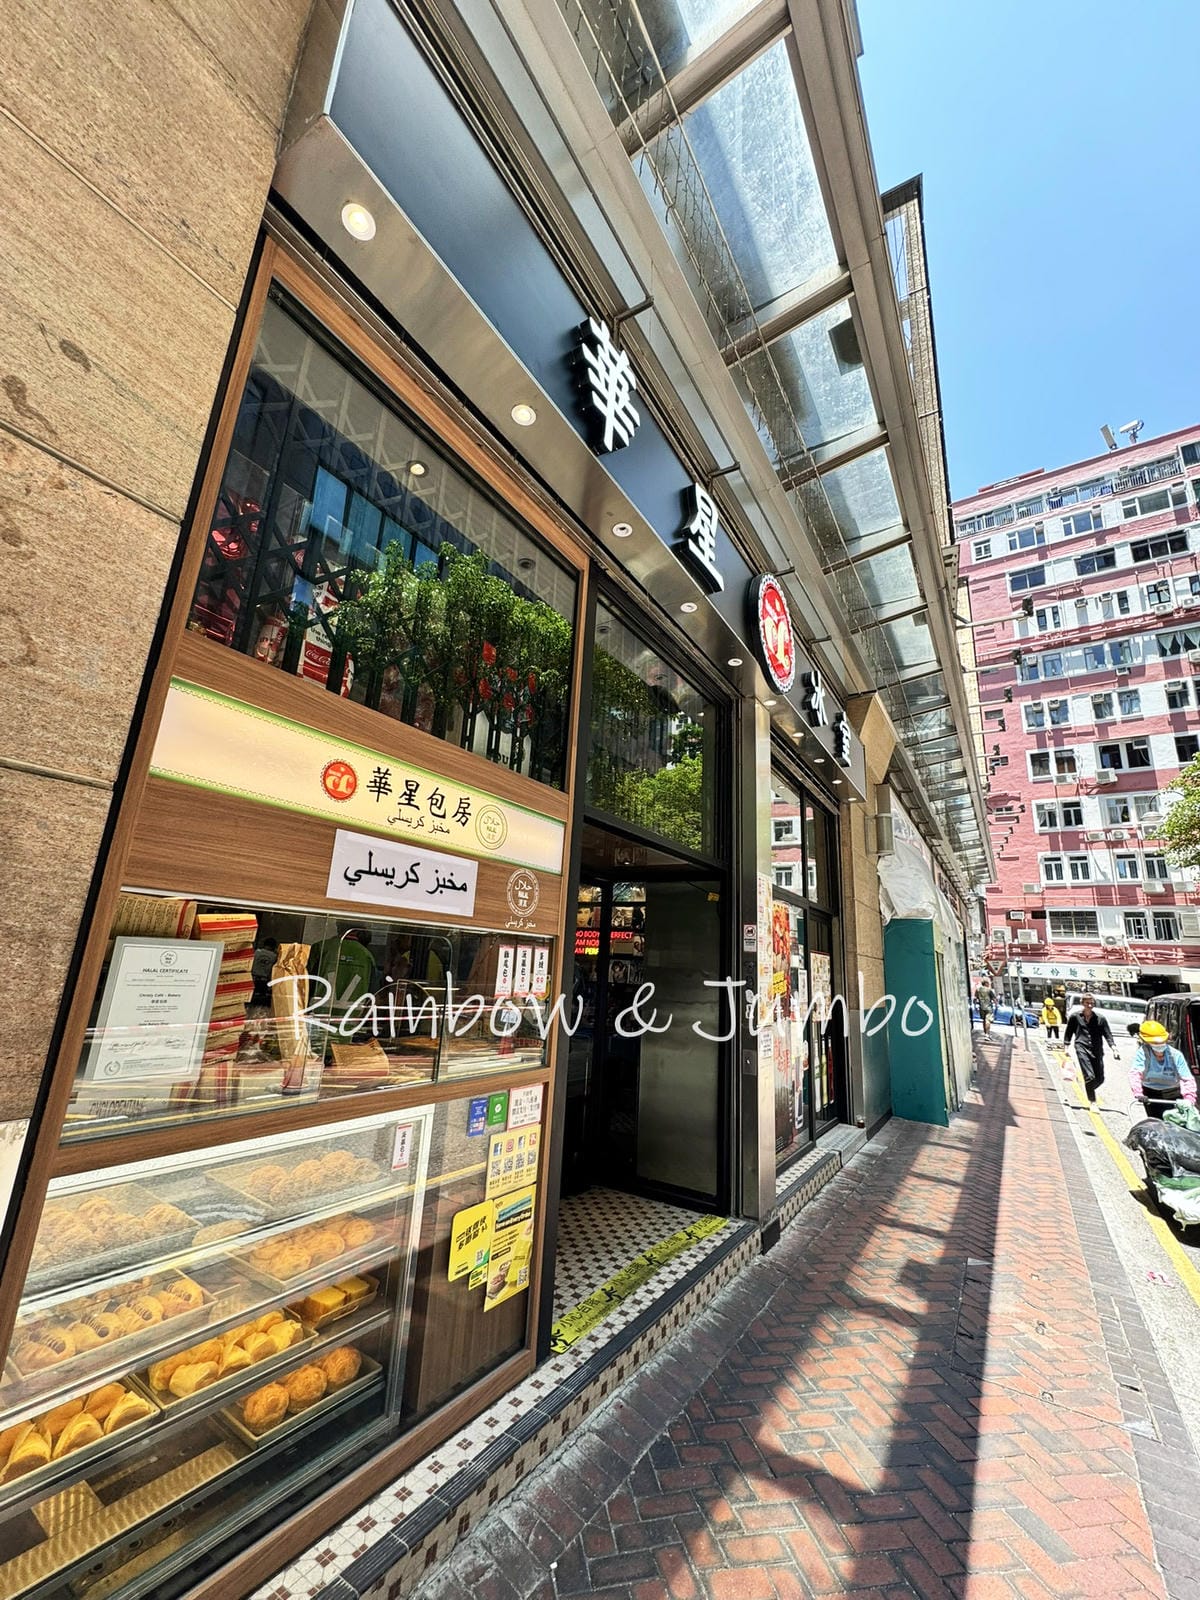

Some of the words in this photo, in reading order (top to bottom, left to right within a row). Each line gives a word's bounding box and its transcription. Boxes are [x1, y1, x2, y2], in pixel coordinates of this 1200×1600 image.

[366, 766, 472, 827] 華星包房
[428, 820, 450, 835] مخبز
[344, 850, 421, 889] كريسلي
[426, 869, 468, 895] مخبز
[610, 931, 633, 939] ERFECT
